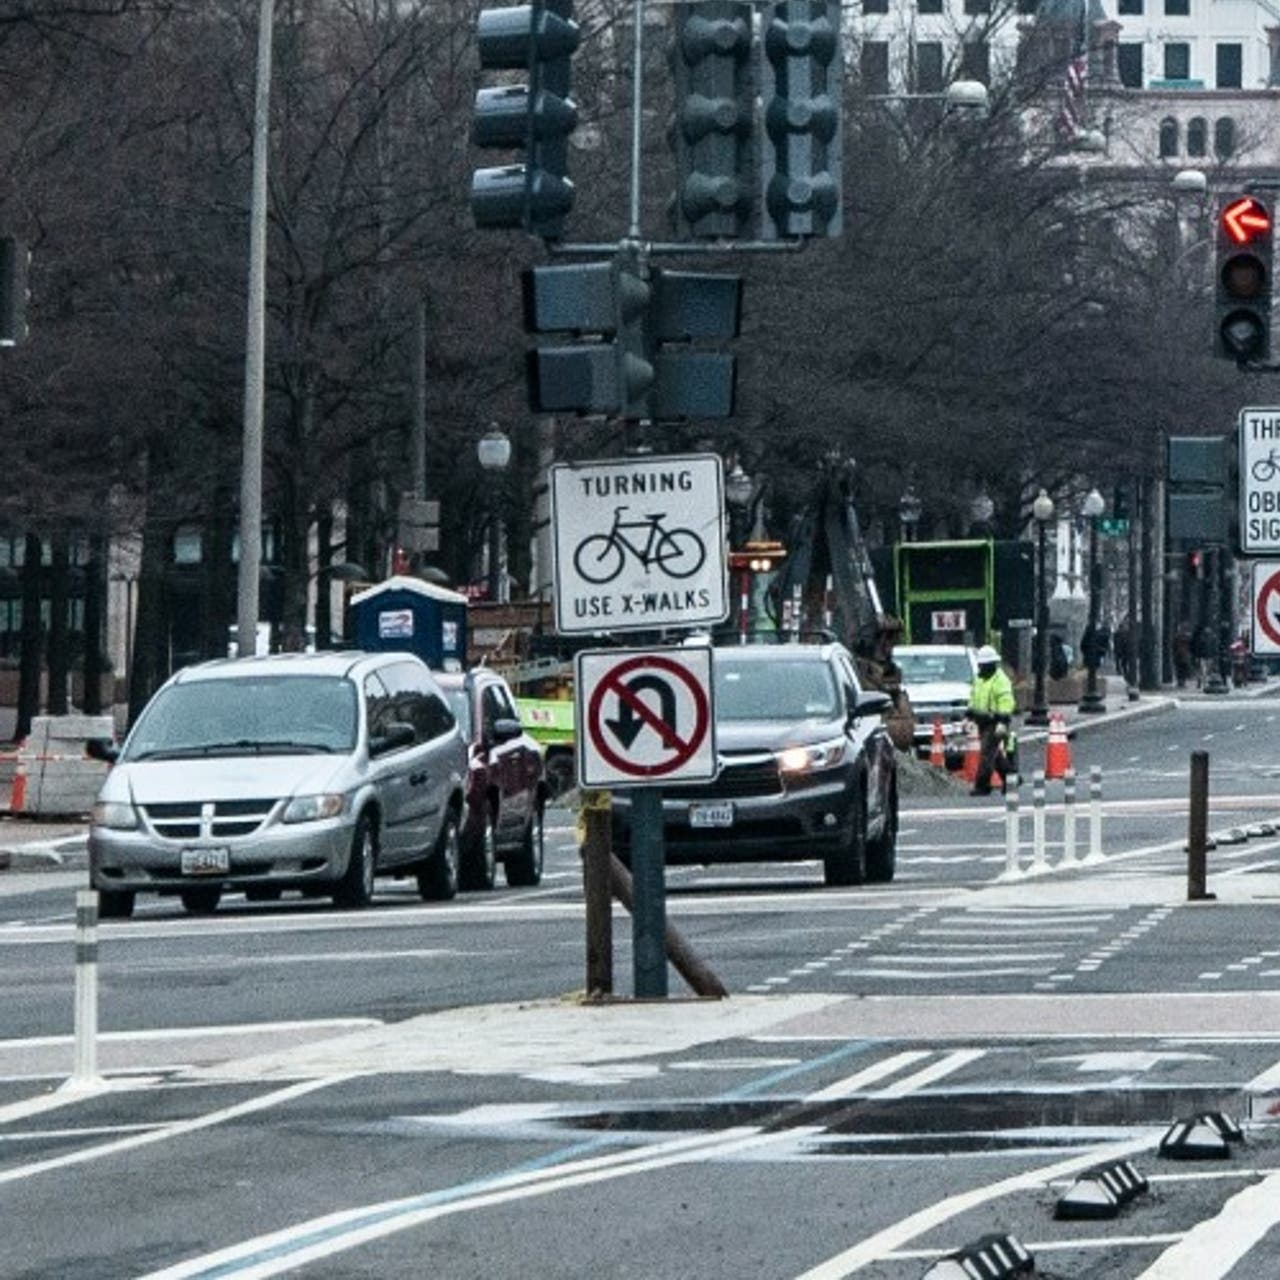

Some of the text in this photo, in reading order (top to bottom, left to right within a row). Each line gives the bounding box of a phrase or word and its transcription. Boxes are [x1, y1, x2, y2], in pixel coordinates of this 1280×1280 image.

[580, 471, 693, 496] TURNING
[575, 589, 710, 617] USE X-WALKS
